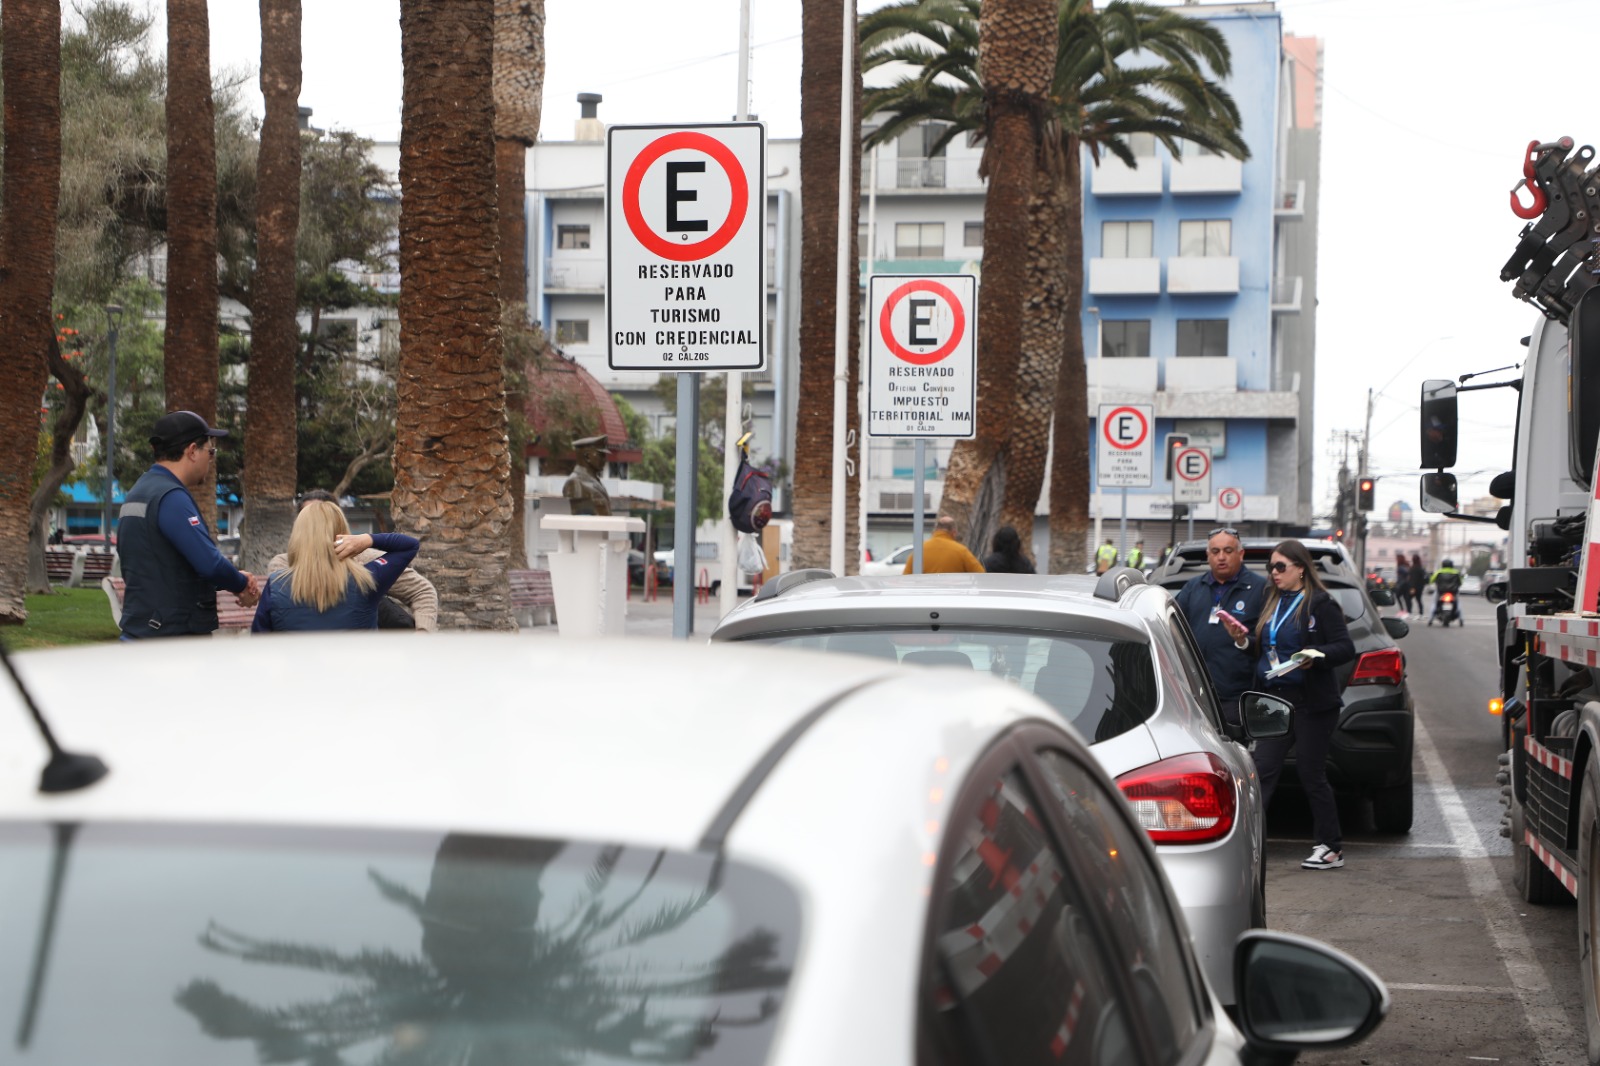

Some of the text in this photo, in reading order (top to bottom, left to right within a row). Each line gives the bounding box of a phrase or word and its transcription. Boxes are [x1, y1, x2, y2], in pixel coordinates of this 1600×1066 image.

[666, 161, 709, 232] E
[638, 263, 734, 279] RESERVADO
[664, 286, 706, 301] PARA
[650, 308, 720, 323] TURISMO
[909, 299, 937, 346] E
[615, 330, 757, 345] CON CREDENCIAL
[662, 352, 710, 361] 02 CALZOS
[889, 367, 954, 377] RESERVADO
[893, 396, 949, 406] IMPUESTO
[871, 411, 971, 421] TERRITORIAL IMA
[1119, 416, 1133, 440] E
[1185, 456, 1200, 474] E
